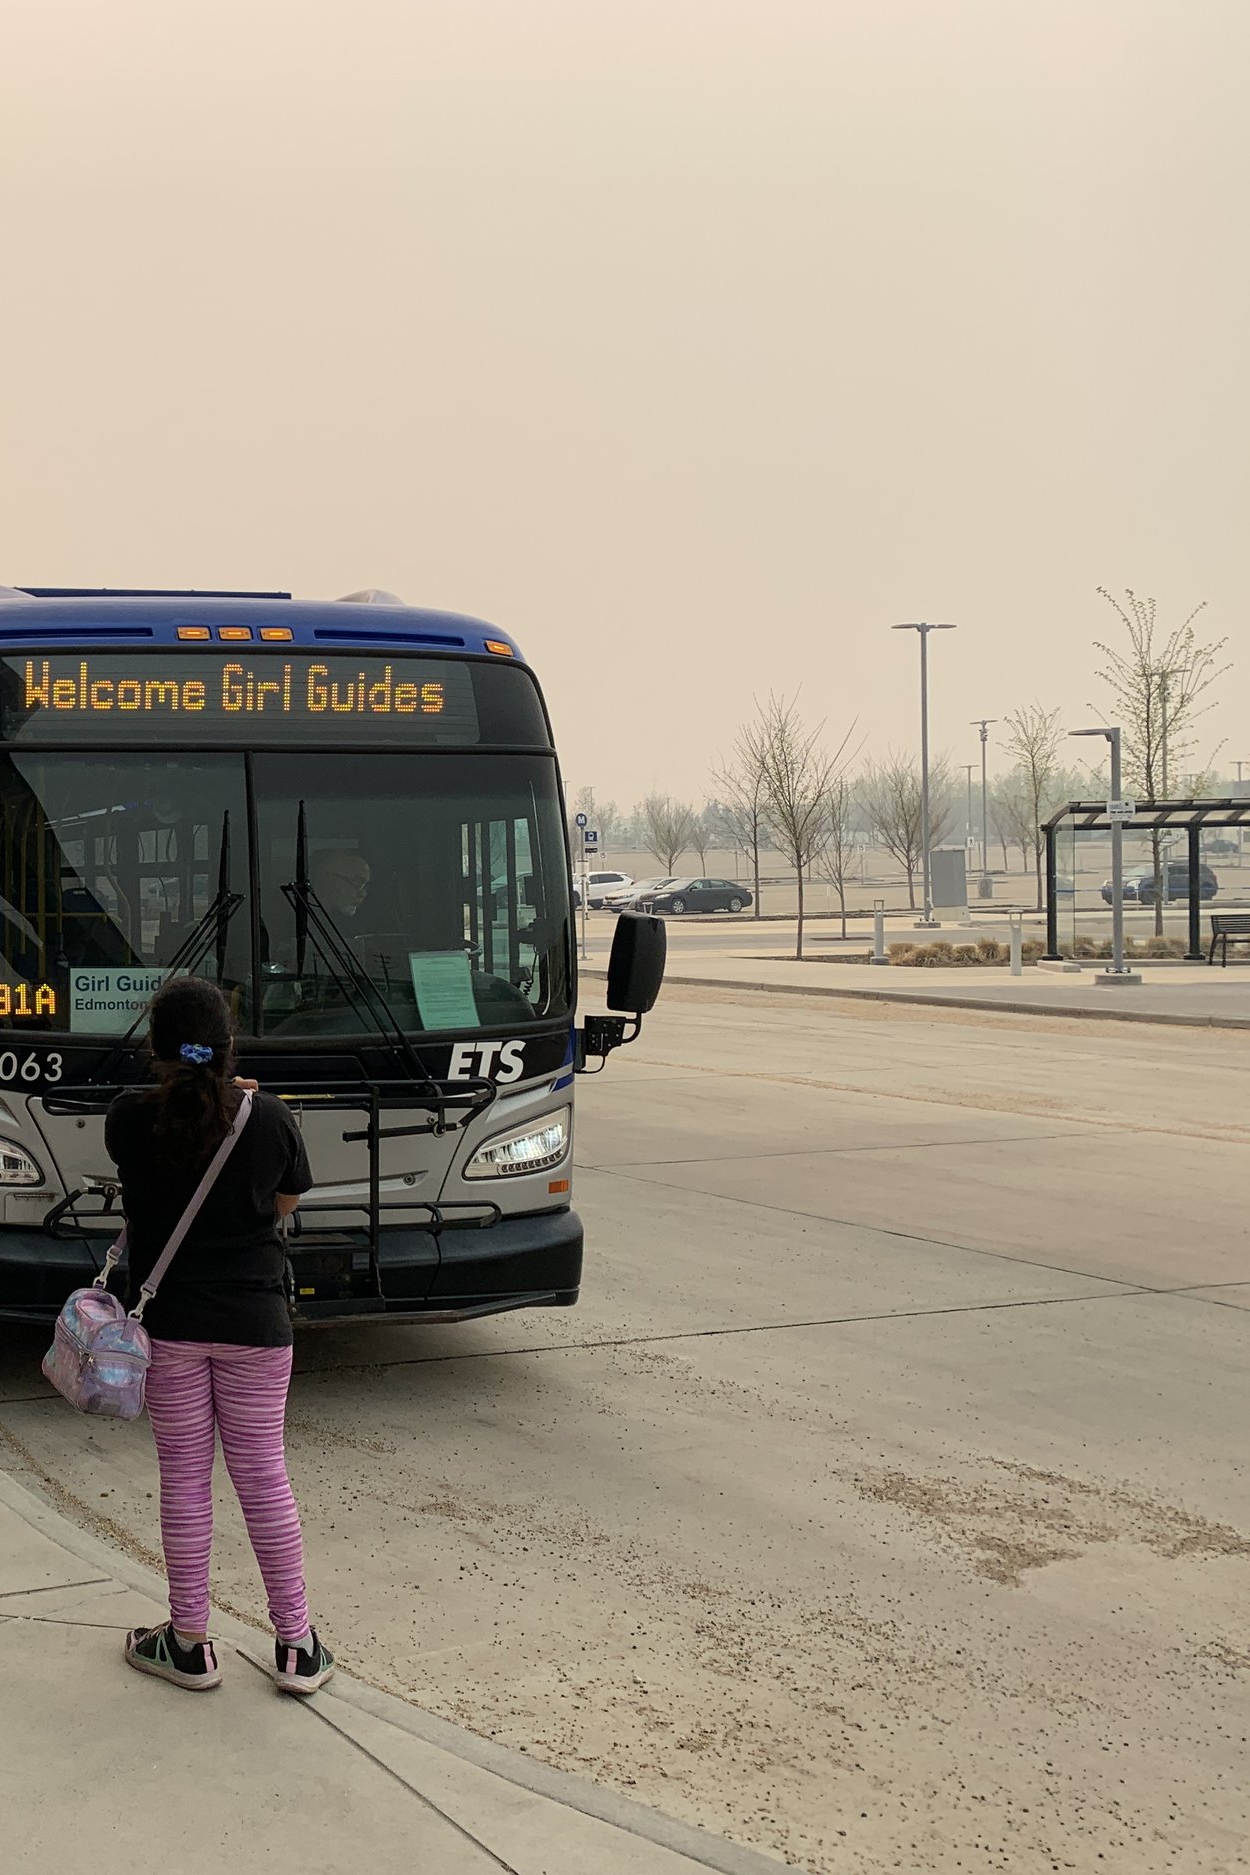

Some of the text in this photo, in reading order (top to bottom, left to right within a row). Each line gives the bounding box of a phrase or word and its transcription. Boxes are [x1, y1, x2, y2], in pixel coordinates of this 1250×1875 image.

[25, 660, 444, 713] Welcome Girl Guides
[75, 975, 162, 992] Girl Guid
[447, 1040, 526, 1083] ETS
